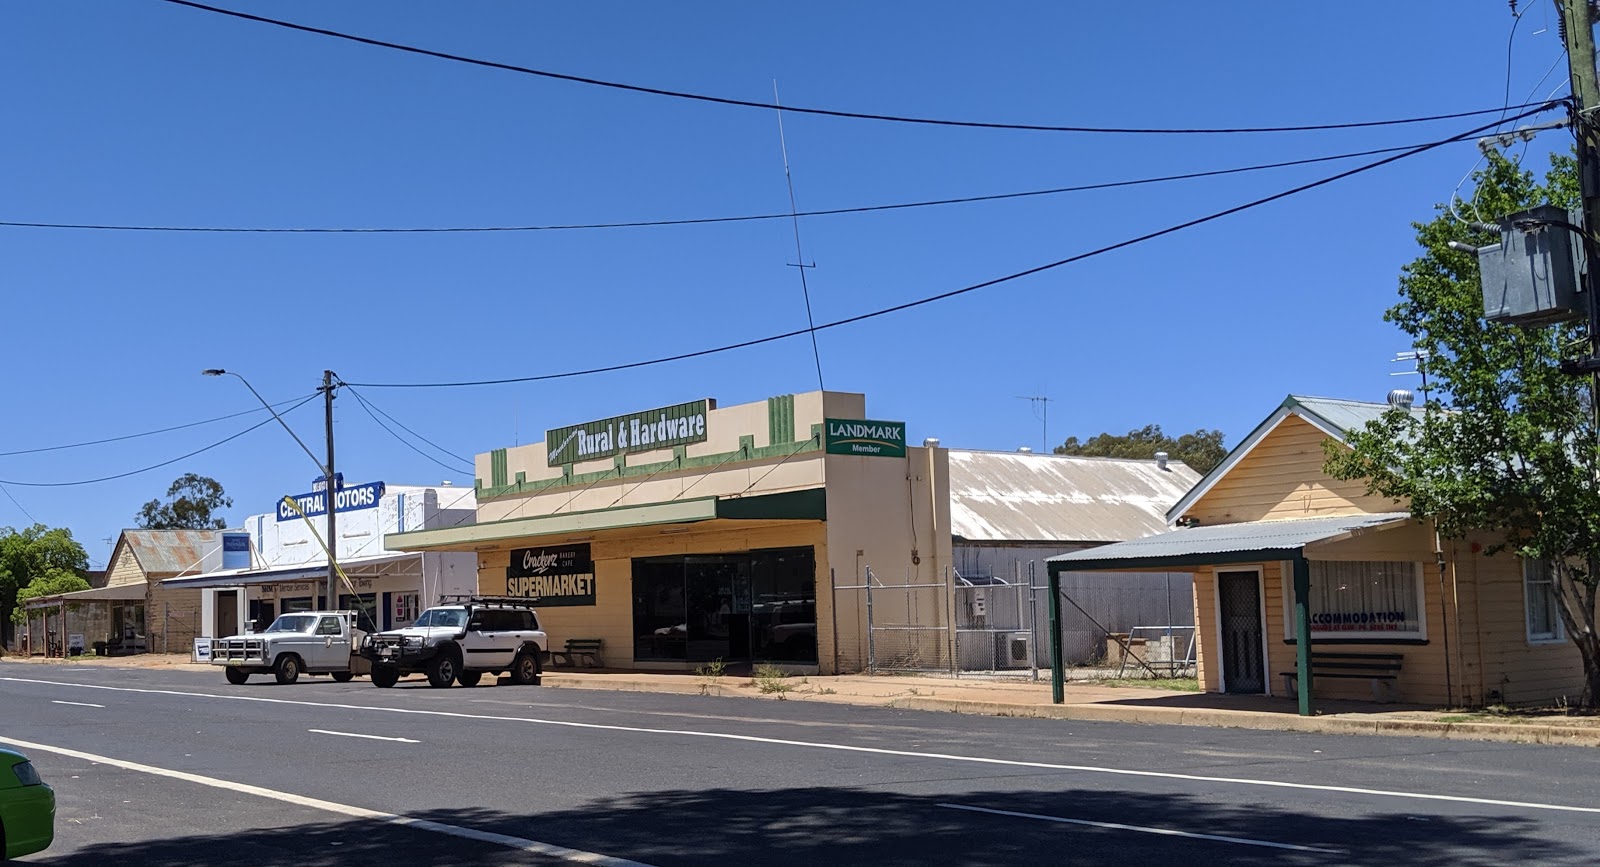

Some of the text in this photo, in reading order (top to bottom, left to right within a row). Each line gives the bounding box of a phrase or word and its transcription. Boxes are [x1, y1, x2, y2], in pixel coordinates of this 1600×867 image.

[578, 423, 613, 456] Rural
[617, 420, 628, 449] &
[629, 413, 705, 448] Hardware
[829, 422, 902, 440] LANDMARK
[852, 444, 881, 453] Member
[523, 549, 558, 570] Crackerz
[507, 572, 594, 597] SUPERMARKET
[1310, 611, 1406, 624] CCOMMODATION
